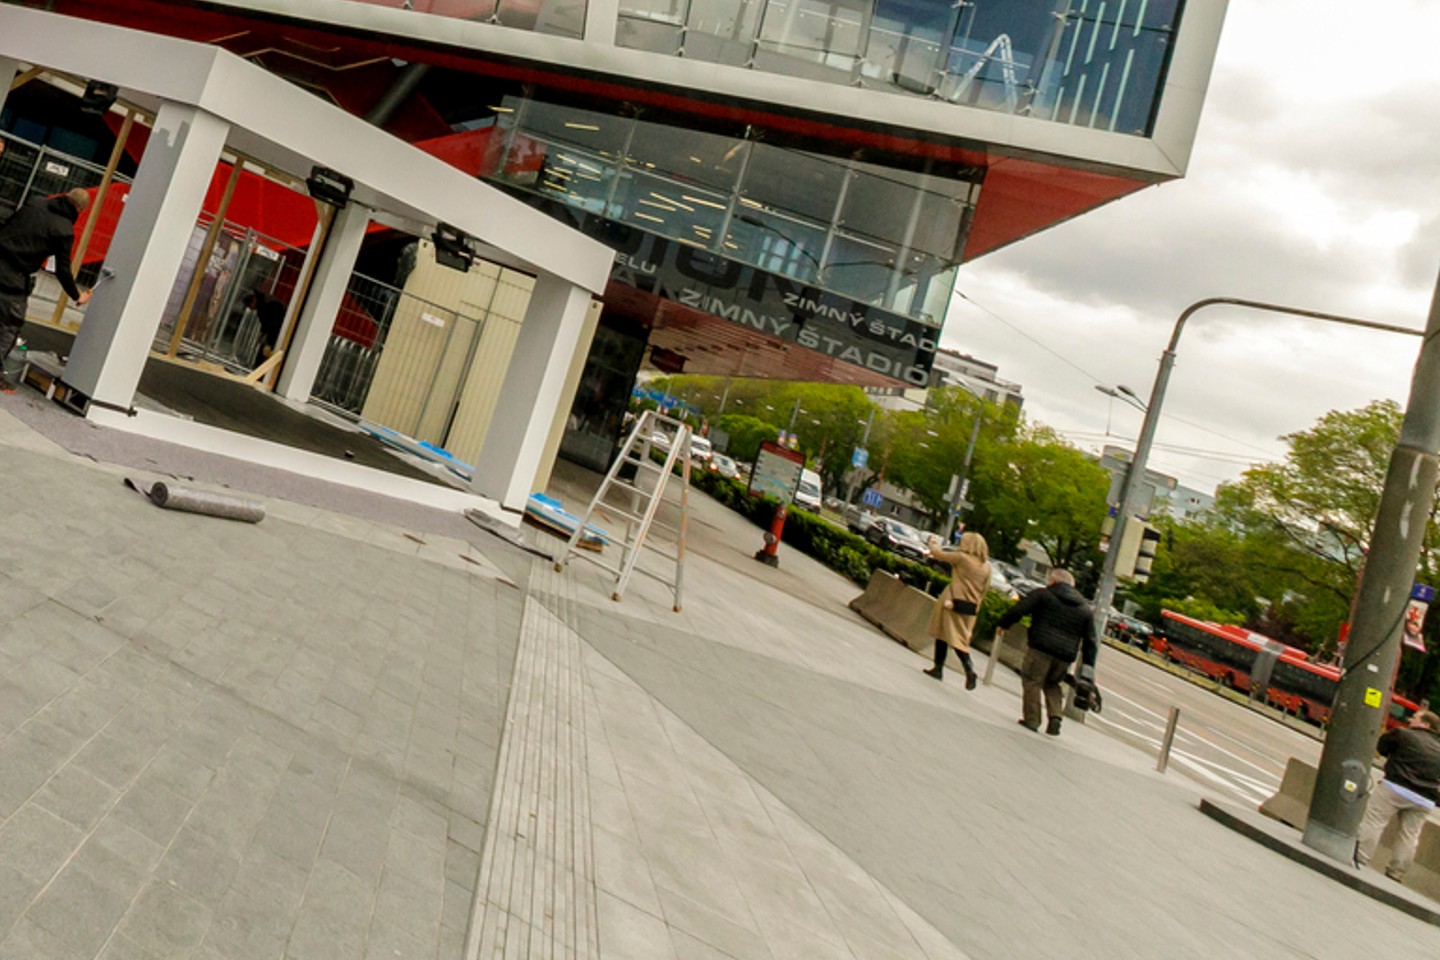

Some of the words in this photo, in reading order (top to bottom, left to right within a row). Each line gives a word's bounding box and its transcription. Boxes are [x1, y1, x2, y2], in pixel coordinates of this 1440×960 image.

[677, 287, 791, 336] ZIMNÝ
[796, 325, 930, 387] ŠTADIÓ
[782, 291, 865, 327] ZIMNÝ
[868, 318, 936, 353] ŠTAD
